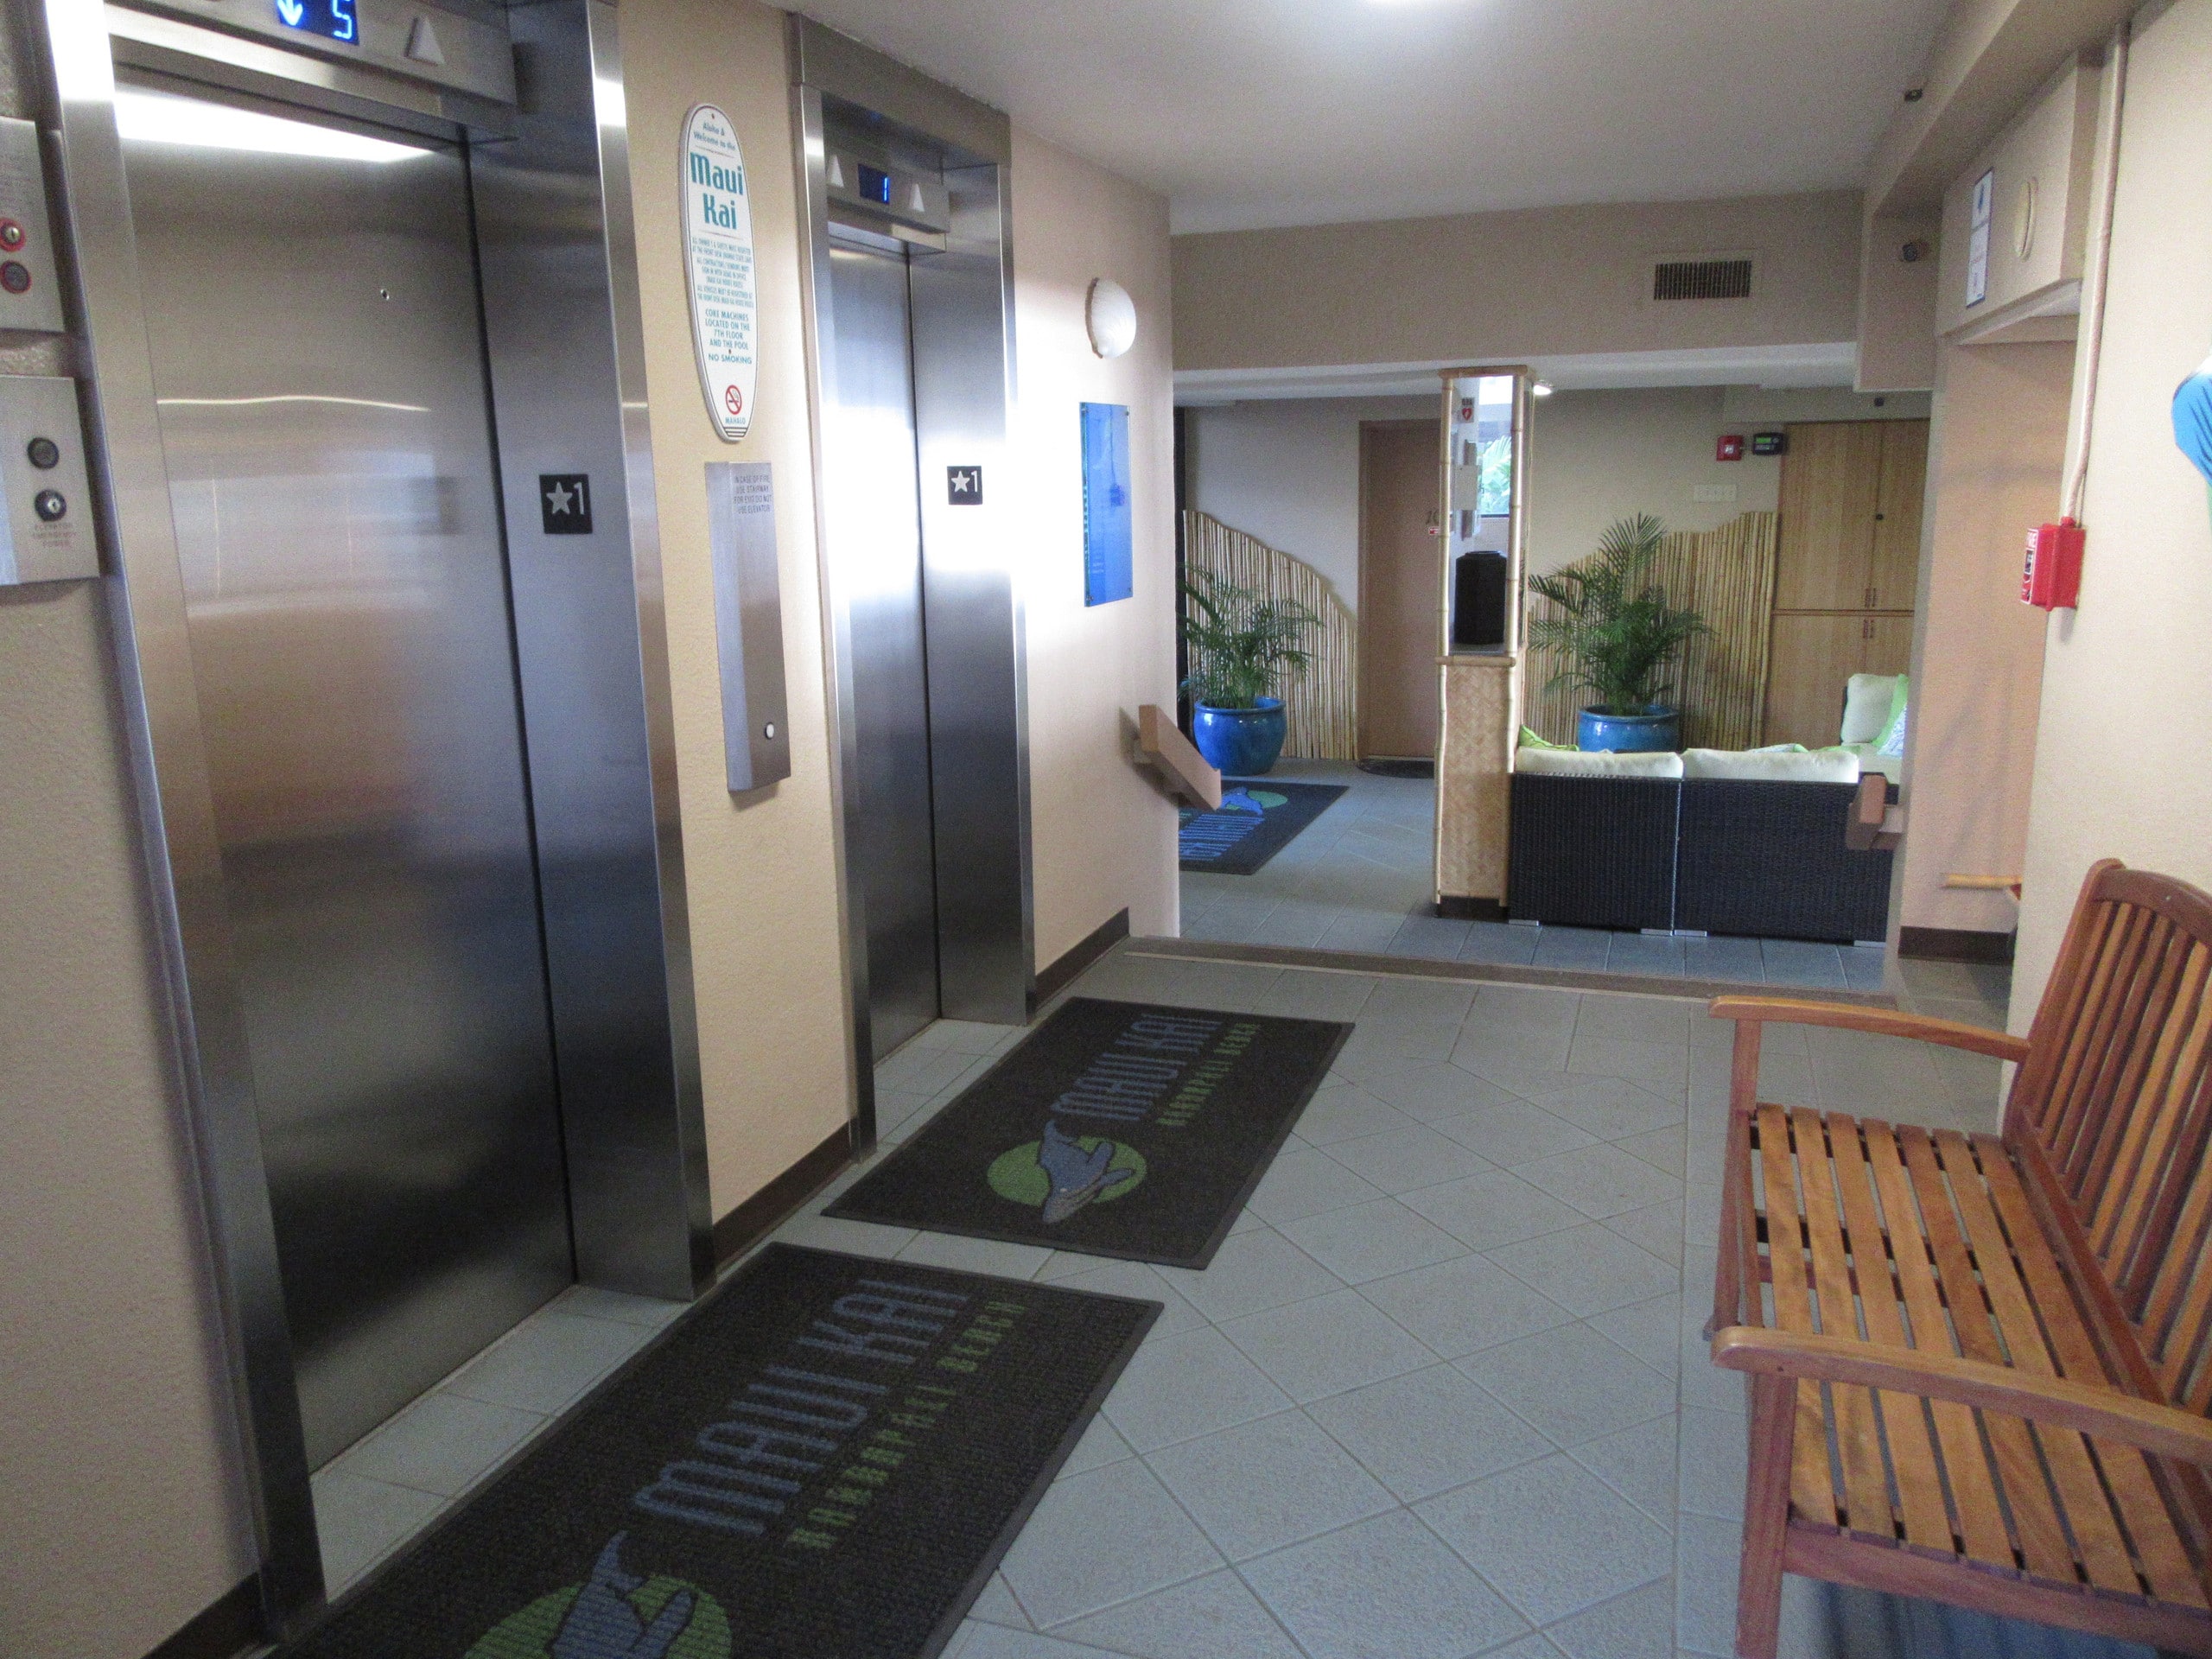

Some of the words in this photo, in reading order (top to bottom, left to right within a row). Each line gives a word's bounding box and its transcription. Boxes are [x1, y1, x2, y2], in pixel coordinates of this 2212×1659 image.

[331, 0, 353, 40] 5
[702, 121, 720, 135] Aloha
[693, 131, 719, 146] Welcome
[727, 142, 735, 150] the
[690, 151, 743, 195] Maui
[702, 192, 737, 231] Kai
[705, 308, 719, 318] COKE
[721, 311, 749, 321] MACHINES
[705, 318, 729, 328] LOCATED
[730, 321, 739, 330] ON
[741, 322, 750, 331] THE
[709, 338, 721, 347] AND
[722, 340, 733, 348] THE
[734, 340, 749, 351] POOL
[714, 328, 724, 337] 7TH
[726, 330, 743, 340] FLOOR
[708, 353, 720, 362] NO
[721, 354, 753, 365] SMOKING
[725, 416, 747, 425] MAHALO
[970, 470, 978, 493] 1
[574, 481, 585, 516] 1
[1115, 1013, 1224, 1056] KAI
[1049, 1052, 1189, 1122] MAUI
[936, 1300, 1028, 1374] BEACH
[632, 1363, 888, 1536] MAUI
[796, 1277, 970, 1365] KAI
